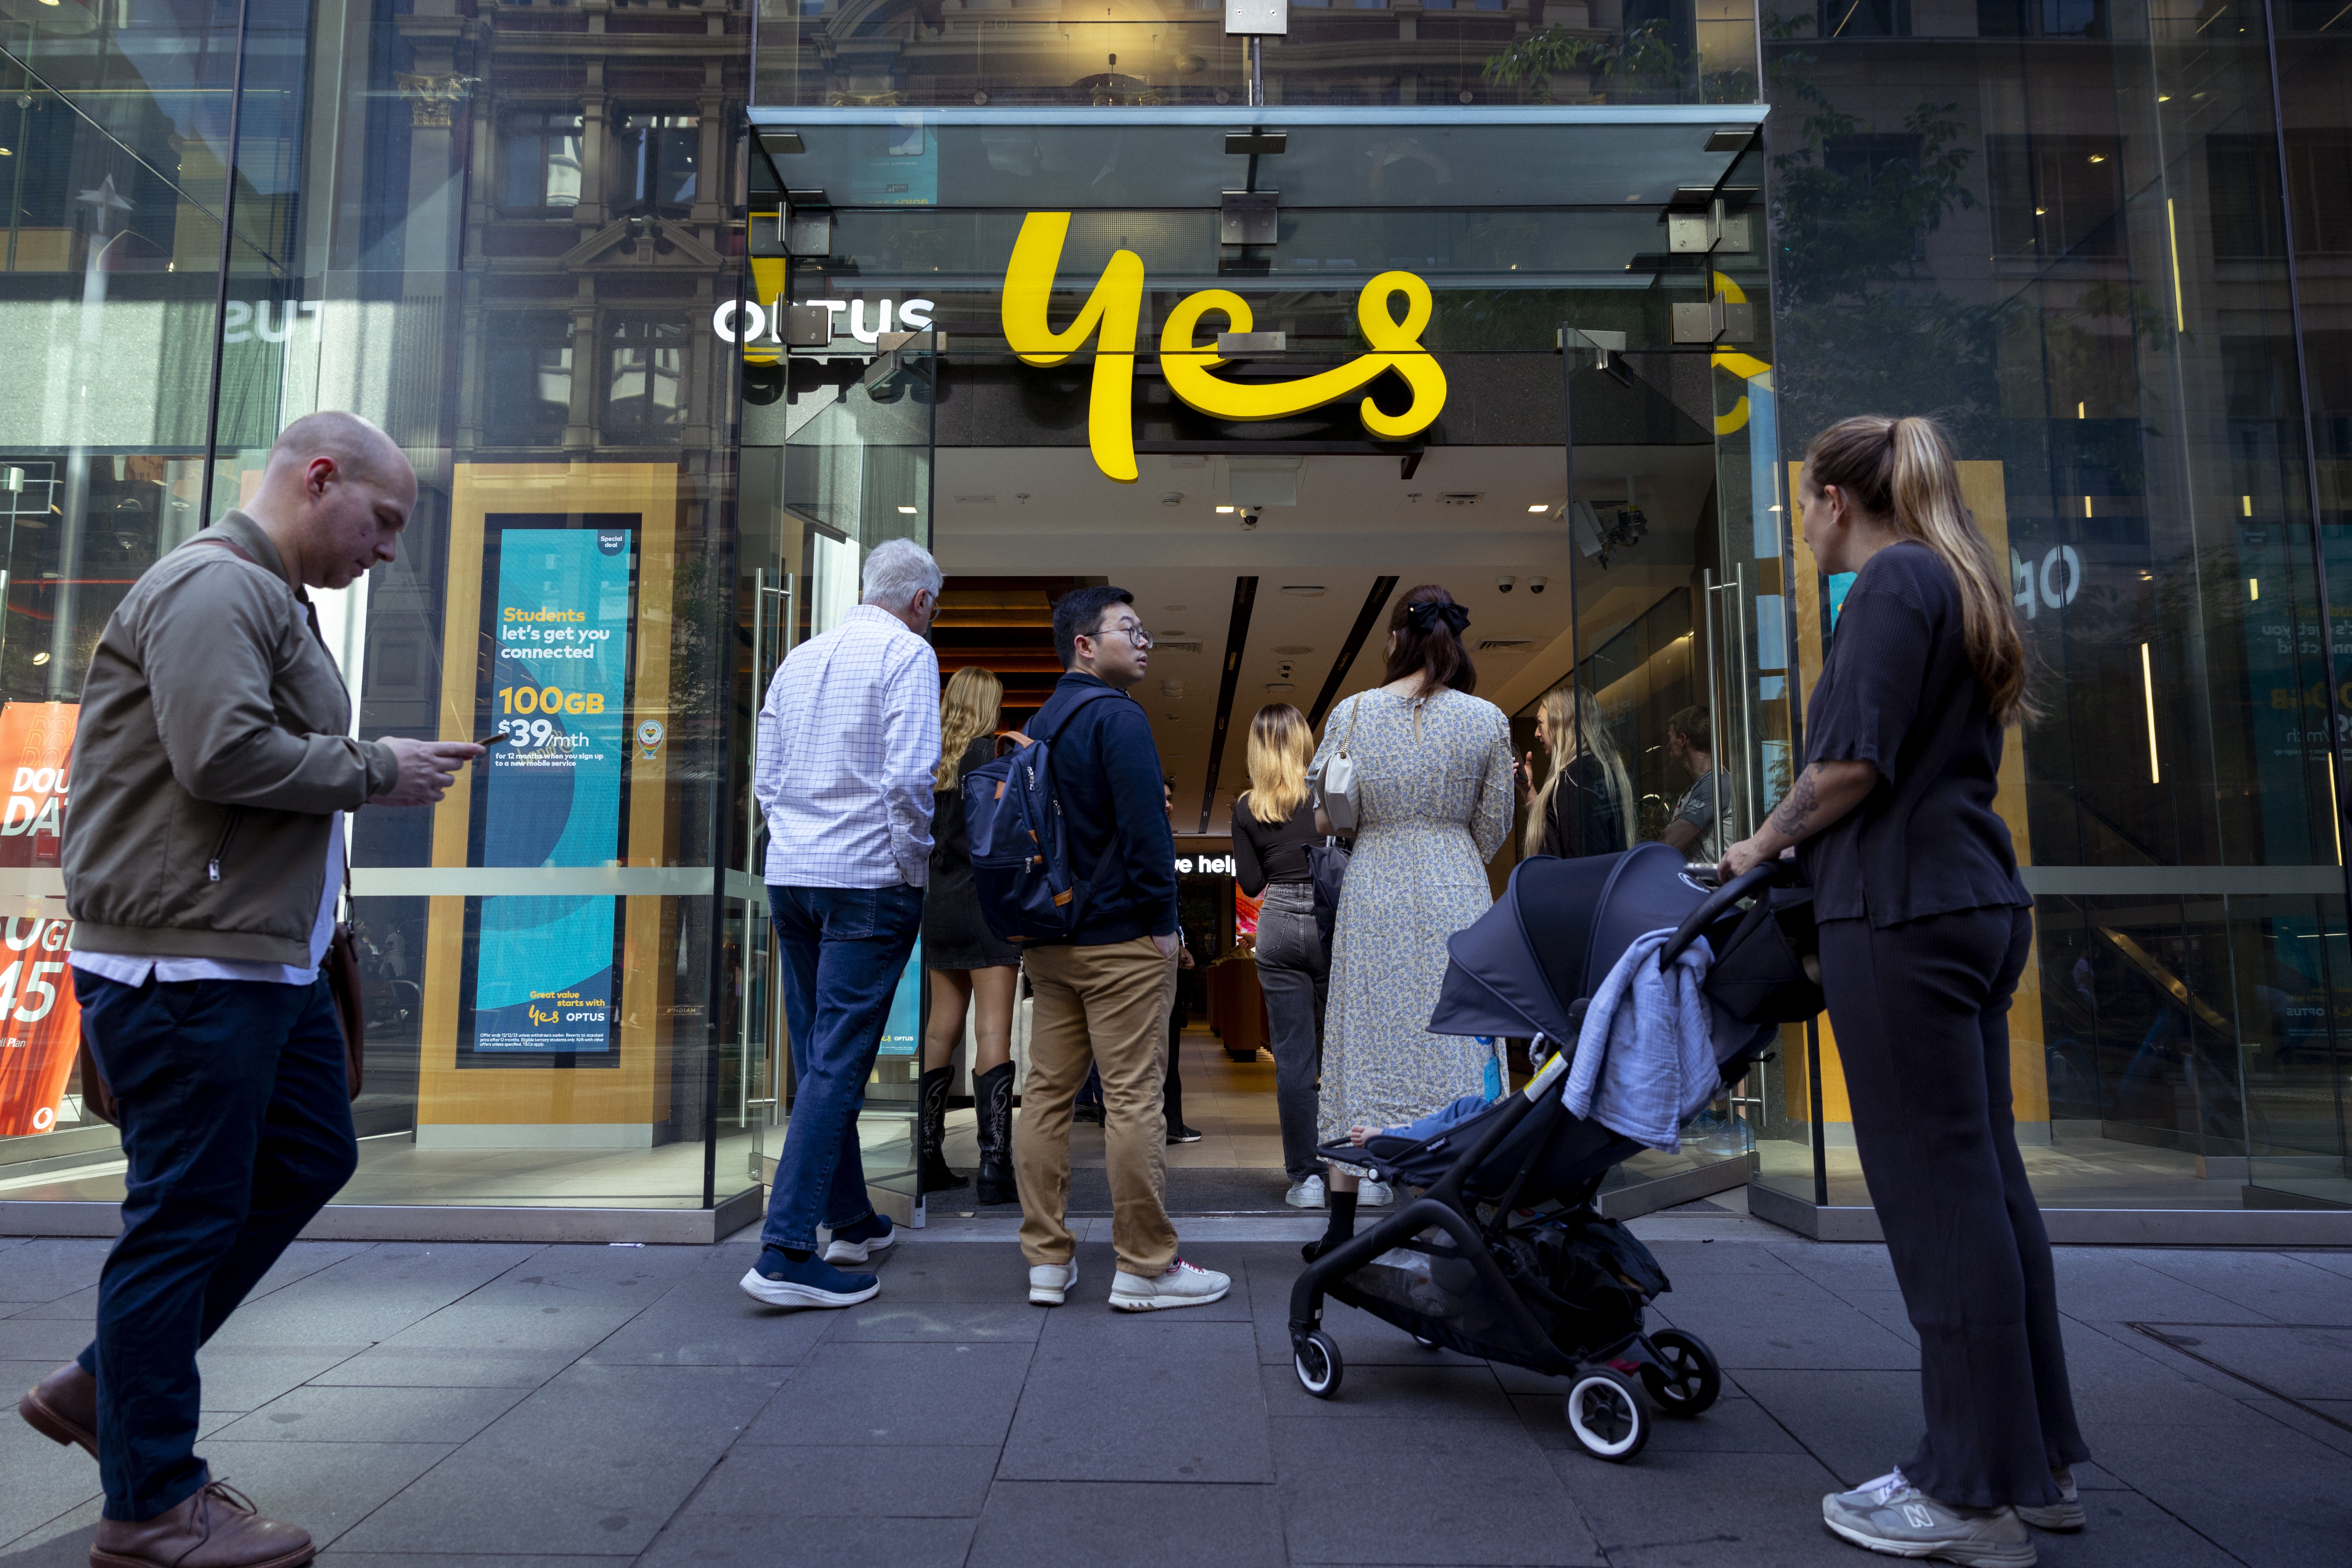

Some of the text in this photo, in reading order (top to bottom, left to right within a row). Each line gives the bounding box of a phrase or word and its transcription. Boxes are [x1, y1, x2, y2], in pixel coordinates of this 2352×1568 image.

[713, 299, 935, 343] OTUS
[503, 607, 585, 622] Students
[503, 625, 610, 644] let's get you
[501, 643, 594, 659] connected
[499, 686, 604, 714] 100GB
[498, 719, 589, 747] $39/mth
[641, 723, 661, 733] WELCOME
[566, 1013, 605, 1022] OPTUS
[7, 1038, 26, 1048] Plan
